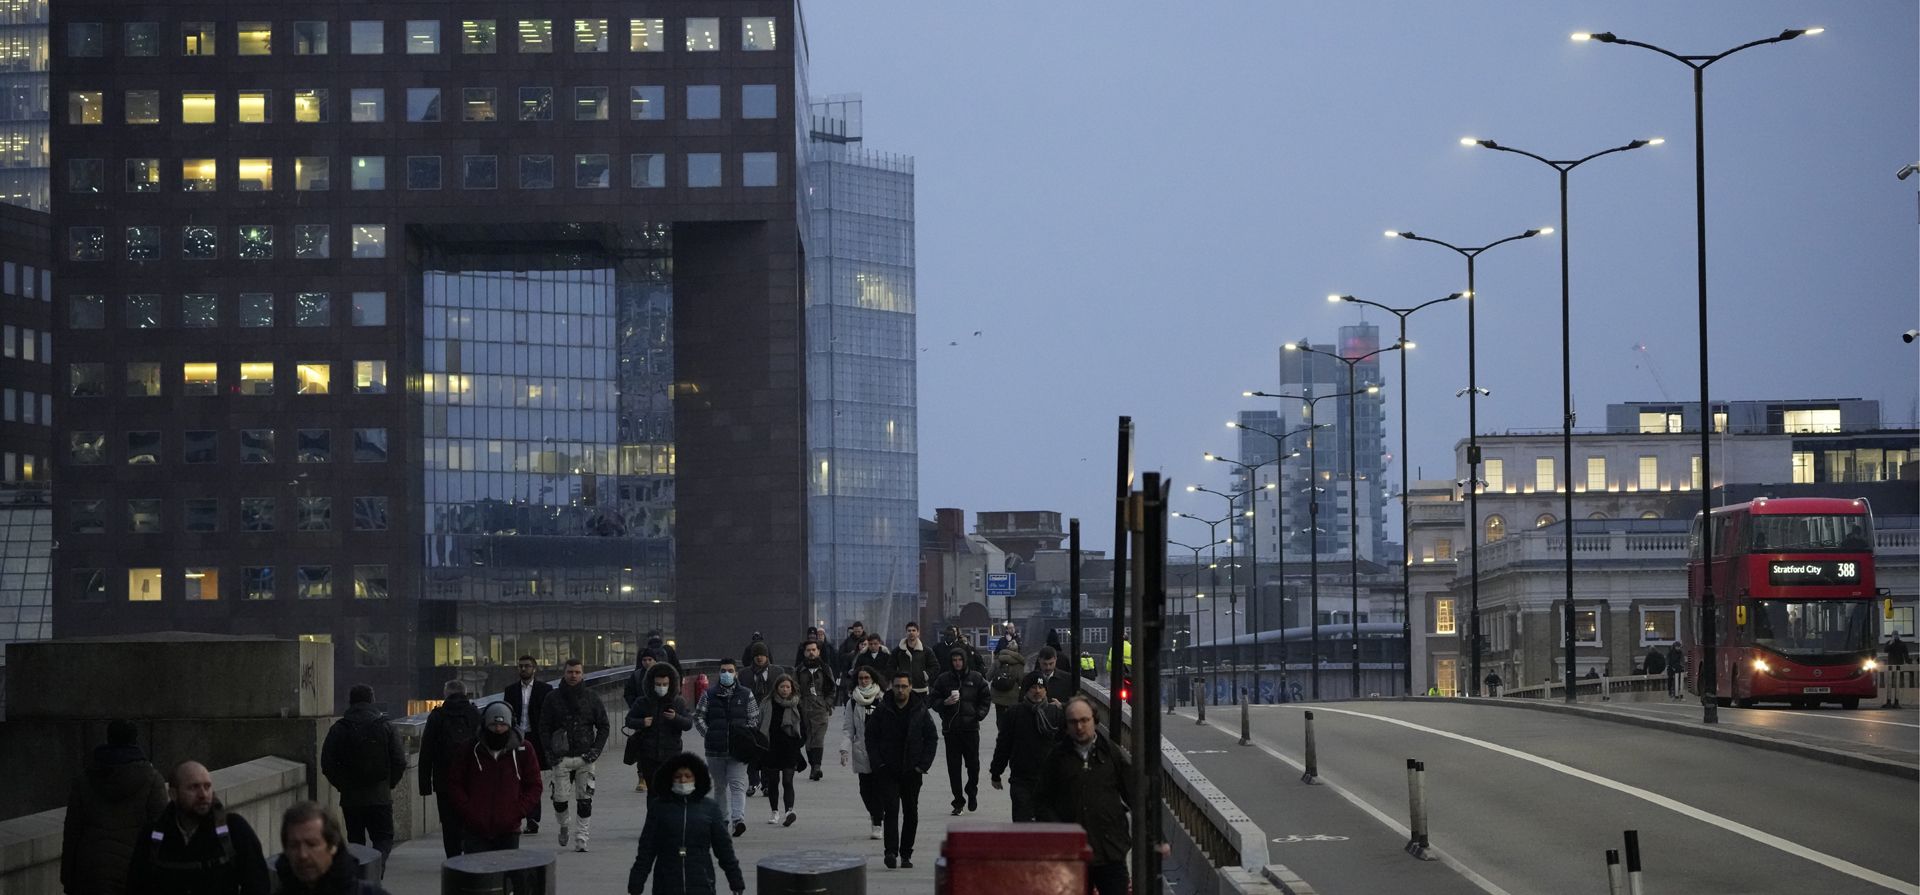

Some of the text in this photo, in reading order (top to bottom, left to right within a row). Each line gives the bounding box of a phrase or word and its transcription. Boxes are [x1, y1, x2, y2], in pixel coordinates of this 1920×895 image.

[1773, 565, 1822, 576] Stratford City
[1837, 563, 1855, 577] 388
